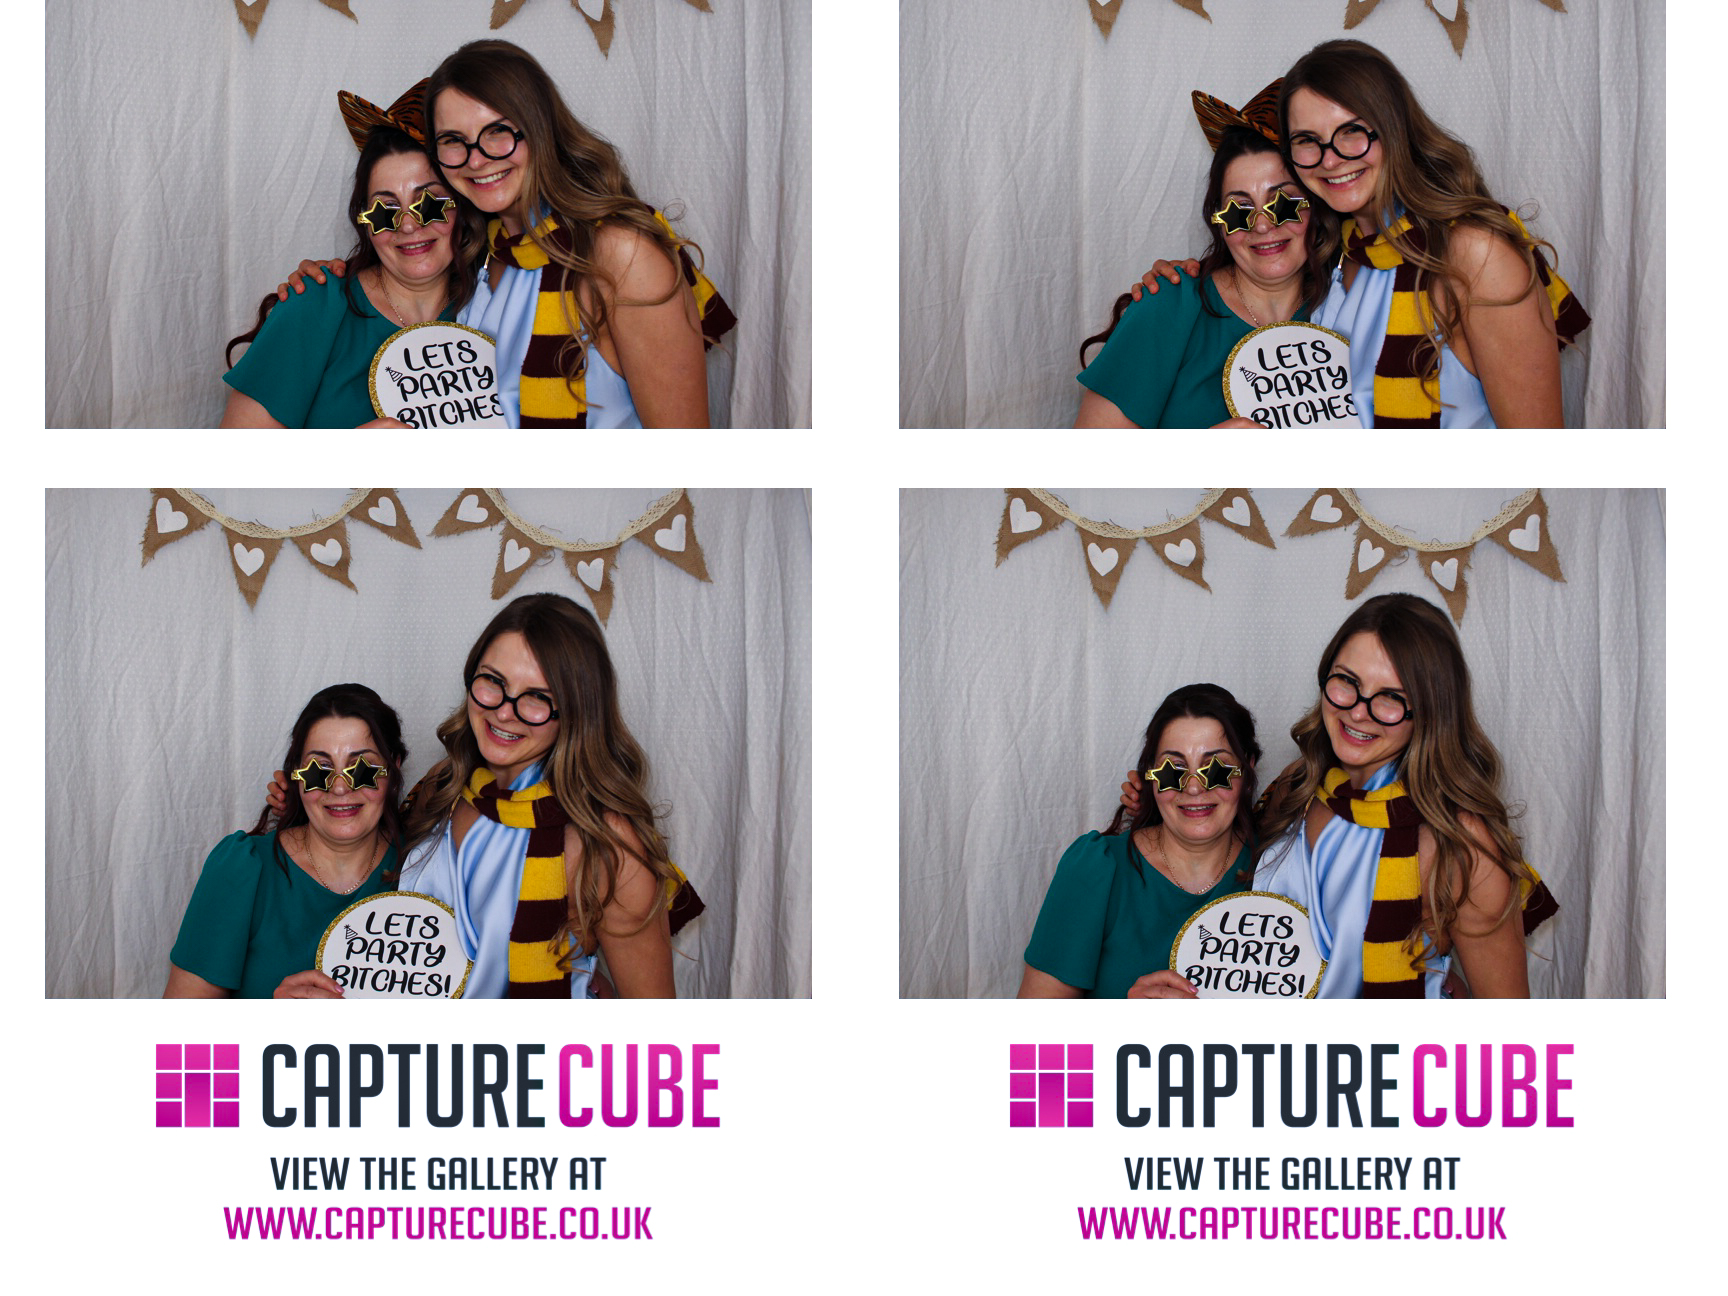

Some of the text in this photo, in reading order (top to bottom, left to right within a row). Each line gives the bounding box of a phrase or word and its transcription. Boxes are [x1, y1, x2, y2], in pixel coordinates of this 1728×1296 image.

[403, 339, 478, 371] LETS
[1257, 339, 1332, 371] LETS
[396, 365, 494, 402] PARTY
[1250, 365, 1348, 402] PARTY
[365, 911, 440, 939] LETS
[1219, 911, 1294, 939] LETS
[345, 936, 447, 968] PARTY
[1199, 936, 1301, 968] PARTY
[331, 965, 452, 998] BITCHES!
[1185, 965, 1306, 998] BITCHES!
